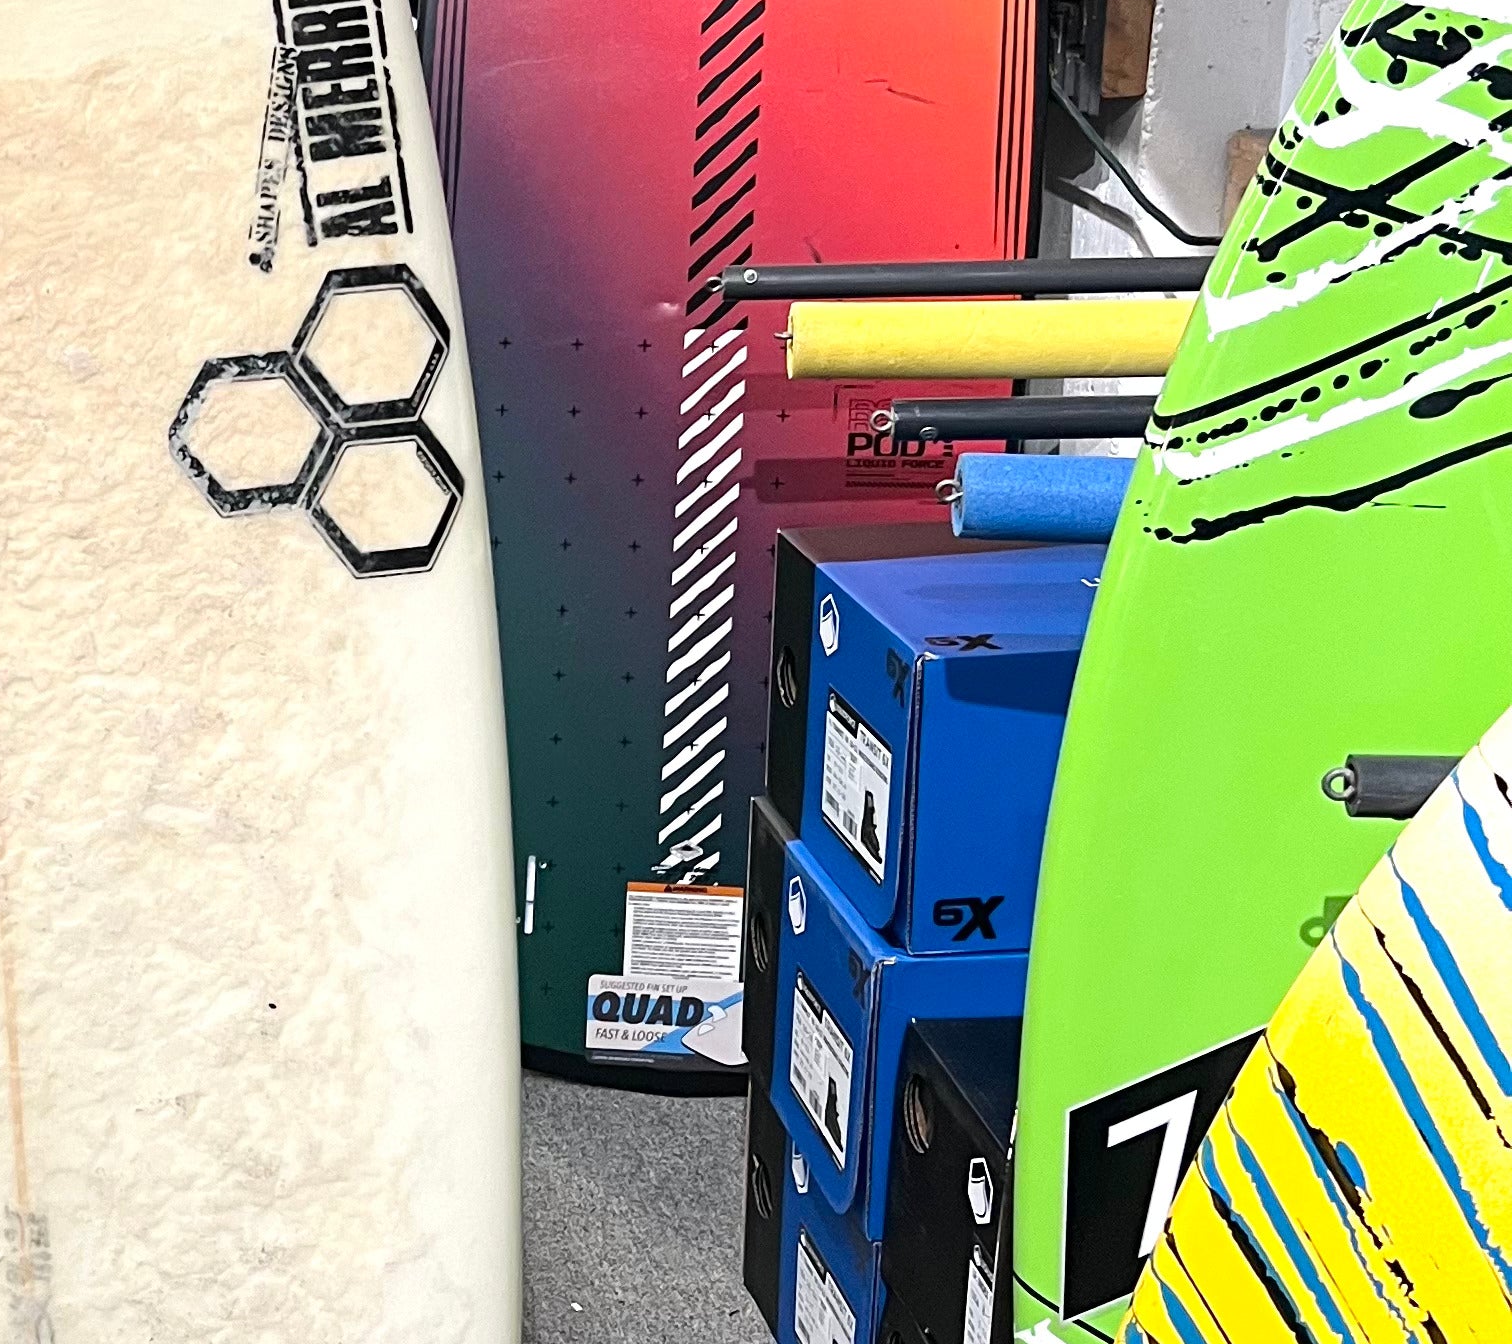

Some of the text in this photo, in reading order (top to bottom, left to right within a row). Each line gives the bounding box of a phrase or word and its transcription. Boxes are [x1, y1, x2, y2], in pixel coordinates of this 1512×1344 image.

[316, 174, 399, 239] AL
[901, 459, 945, 469] FORCE
[932, 895, 1005, 942] 6X
[599, 979, 688, 994] SUGGESTED FIN SET UP
[592, 990, 705, 1028] QUAD
[595, 1027, 667, 1043] FAST & LOOSE
